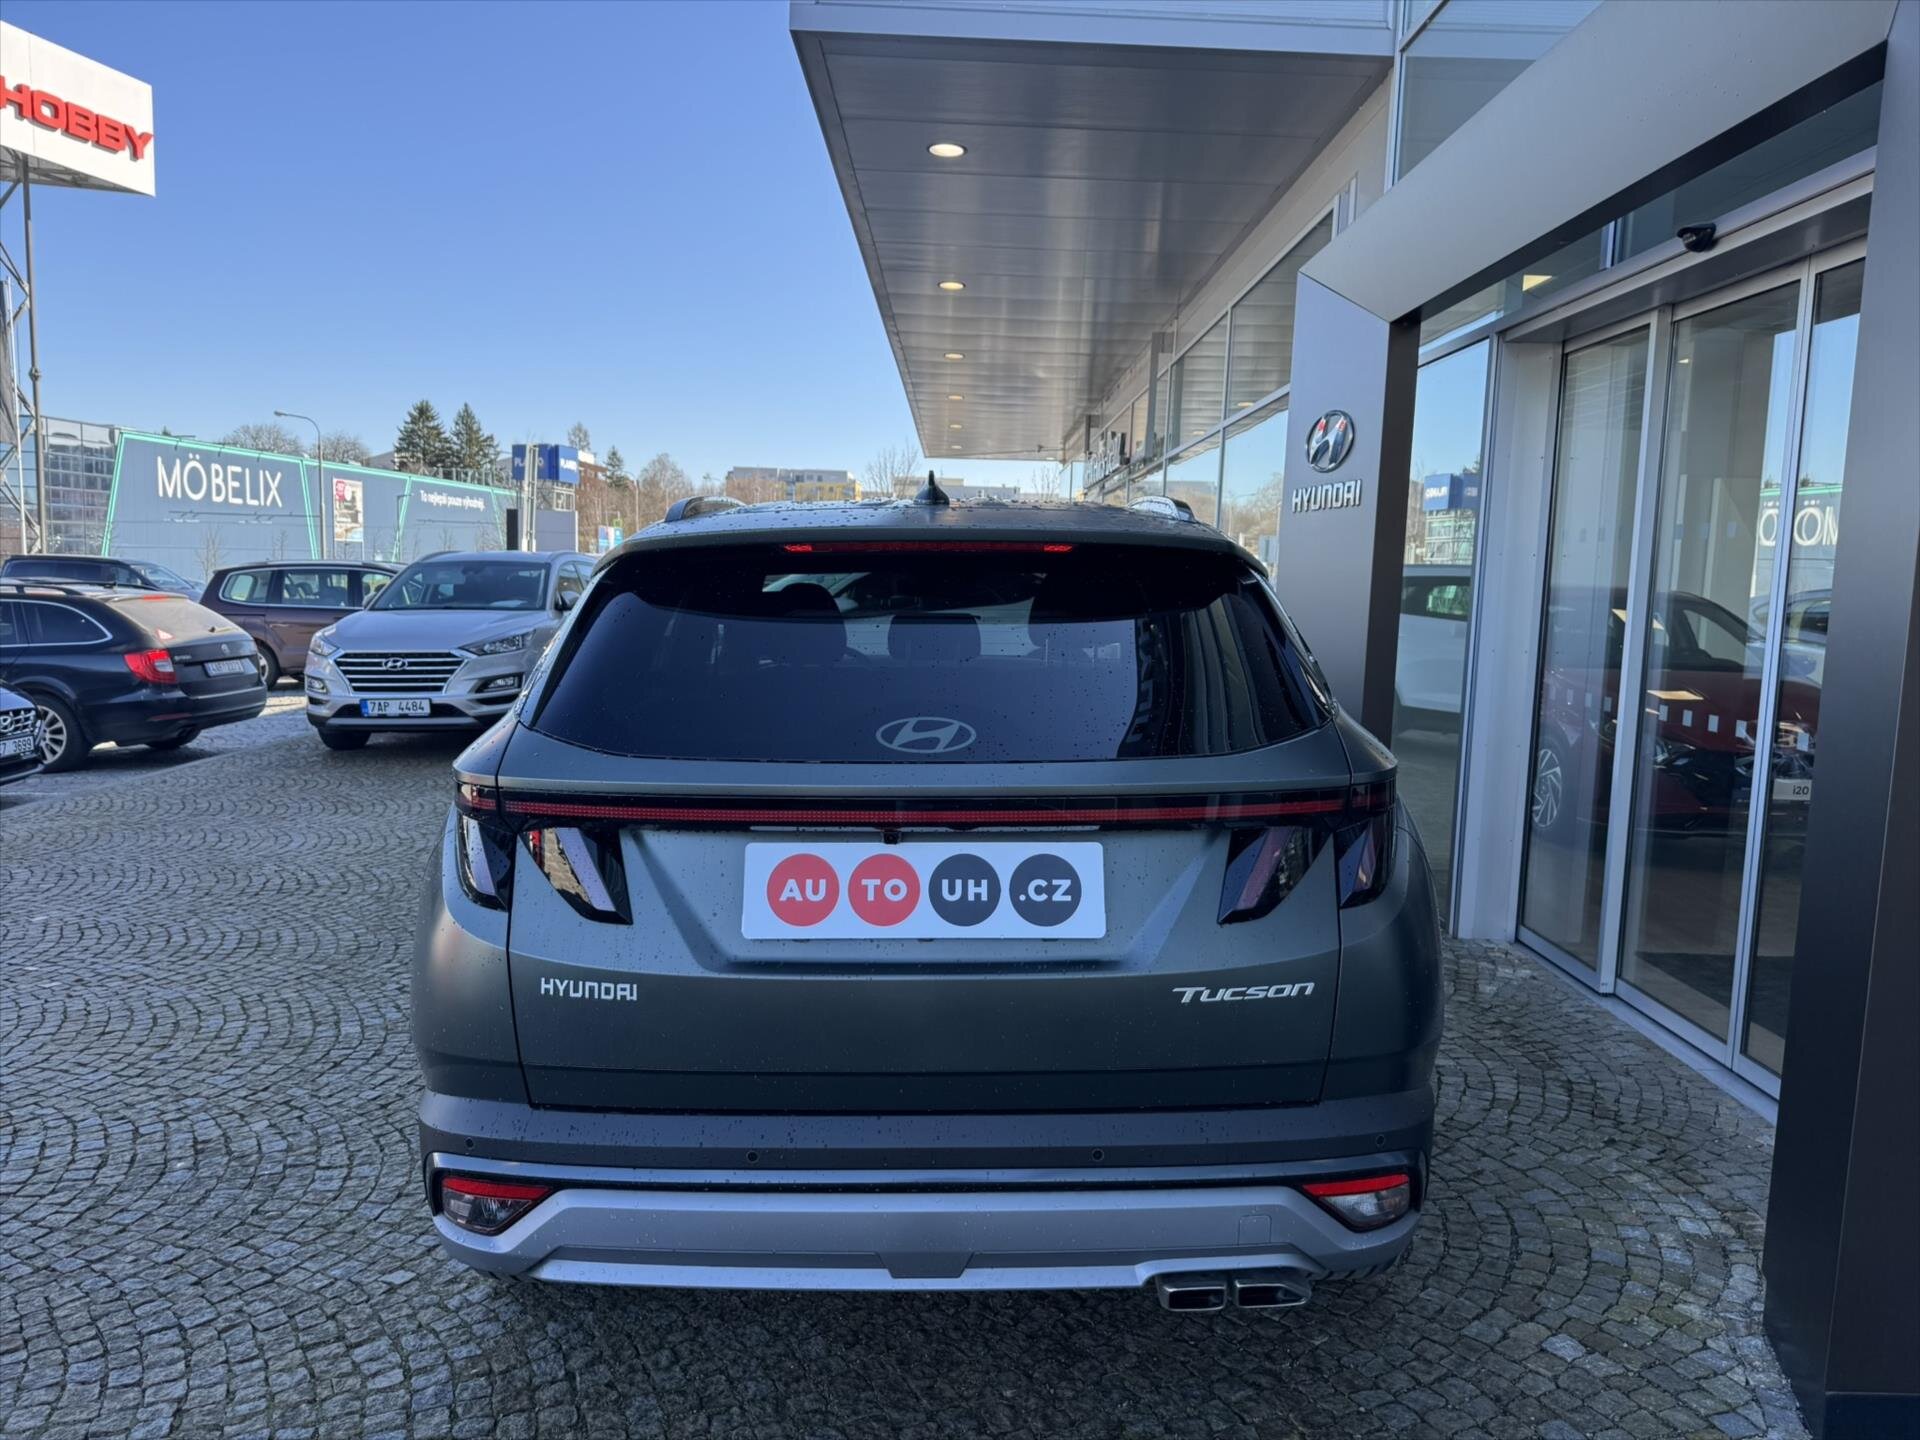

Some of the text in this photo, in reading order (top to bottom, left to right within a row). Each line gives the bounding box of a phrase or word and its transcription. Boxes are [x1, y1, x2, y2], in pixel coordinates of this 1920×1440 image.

[0, 75, 153, 159] HOBBY
[157, 453, 282, 507] MÖBELIX
[1292, 480, 1361, 513] HYUNDAI
[370, 701, 425, 712] 7AP 4484
[12, 738, 31, 752] 3699
[1792, 784, 1810, 796] i20
[779, 878, 1072, 902] AU TO UH .CZ
[540, 977, 638, 1001] HYUNDAI
